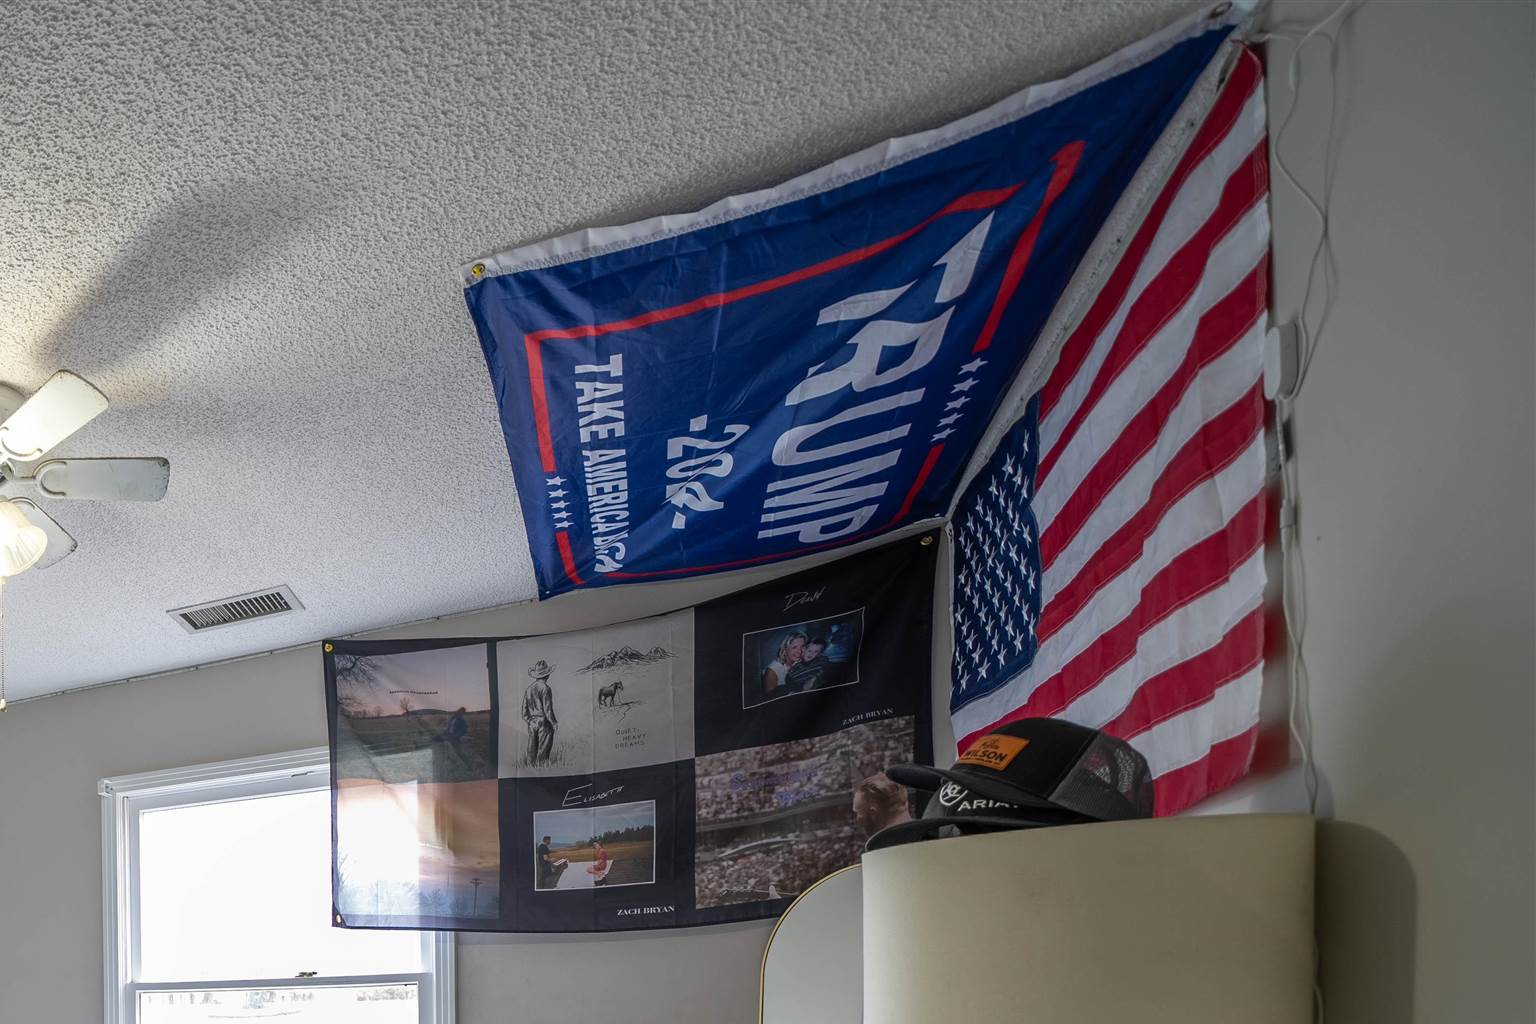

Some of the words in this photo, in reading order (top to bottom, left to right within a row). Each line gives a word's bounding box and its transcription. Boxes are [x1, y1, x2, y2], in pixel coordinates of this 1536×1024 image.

[757, 210, 995, 543] TRUMP
[574, 353, 625, 443] TAKE
[582, 449, 630, 534] AMERICA
[842, 714, 864, 726] ZACH
[865, 708, 894, 719] BRYAN
[965, 749, 1008, 762] WILSON
[958, 800, 1019, 812] ARIA
[616, 907, 641, 916] ZACH
[643, 905, 675, 915] BRYAN
